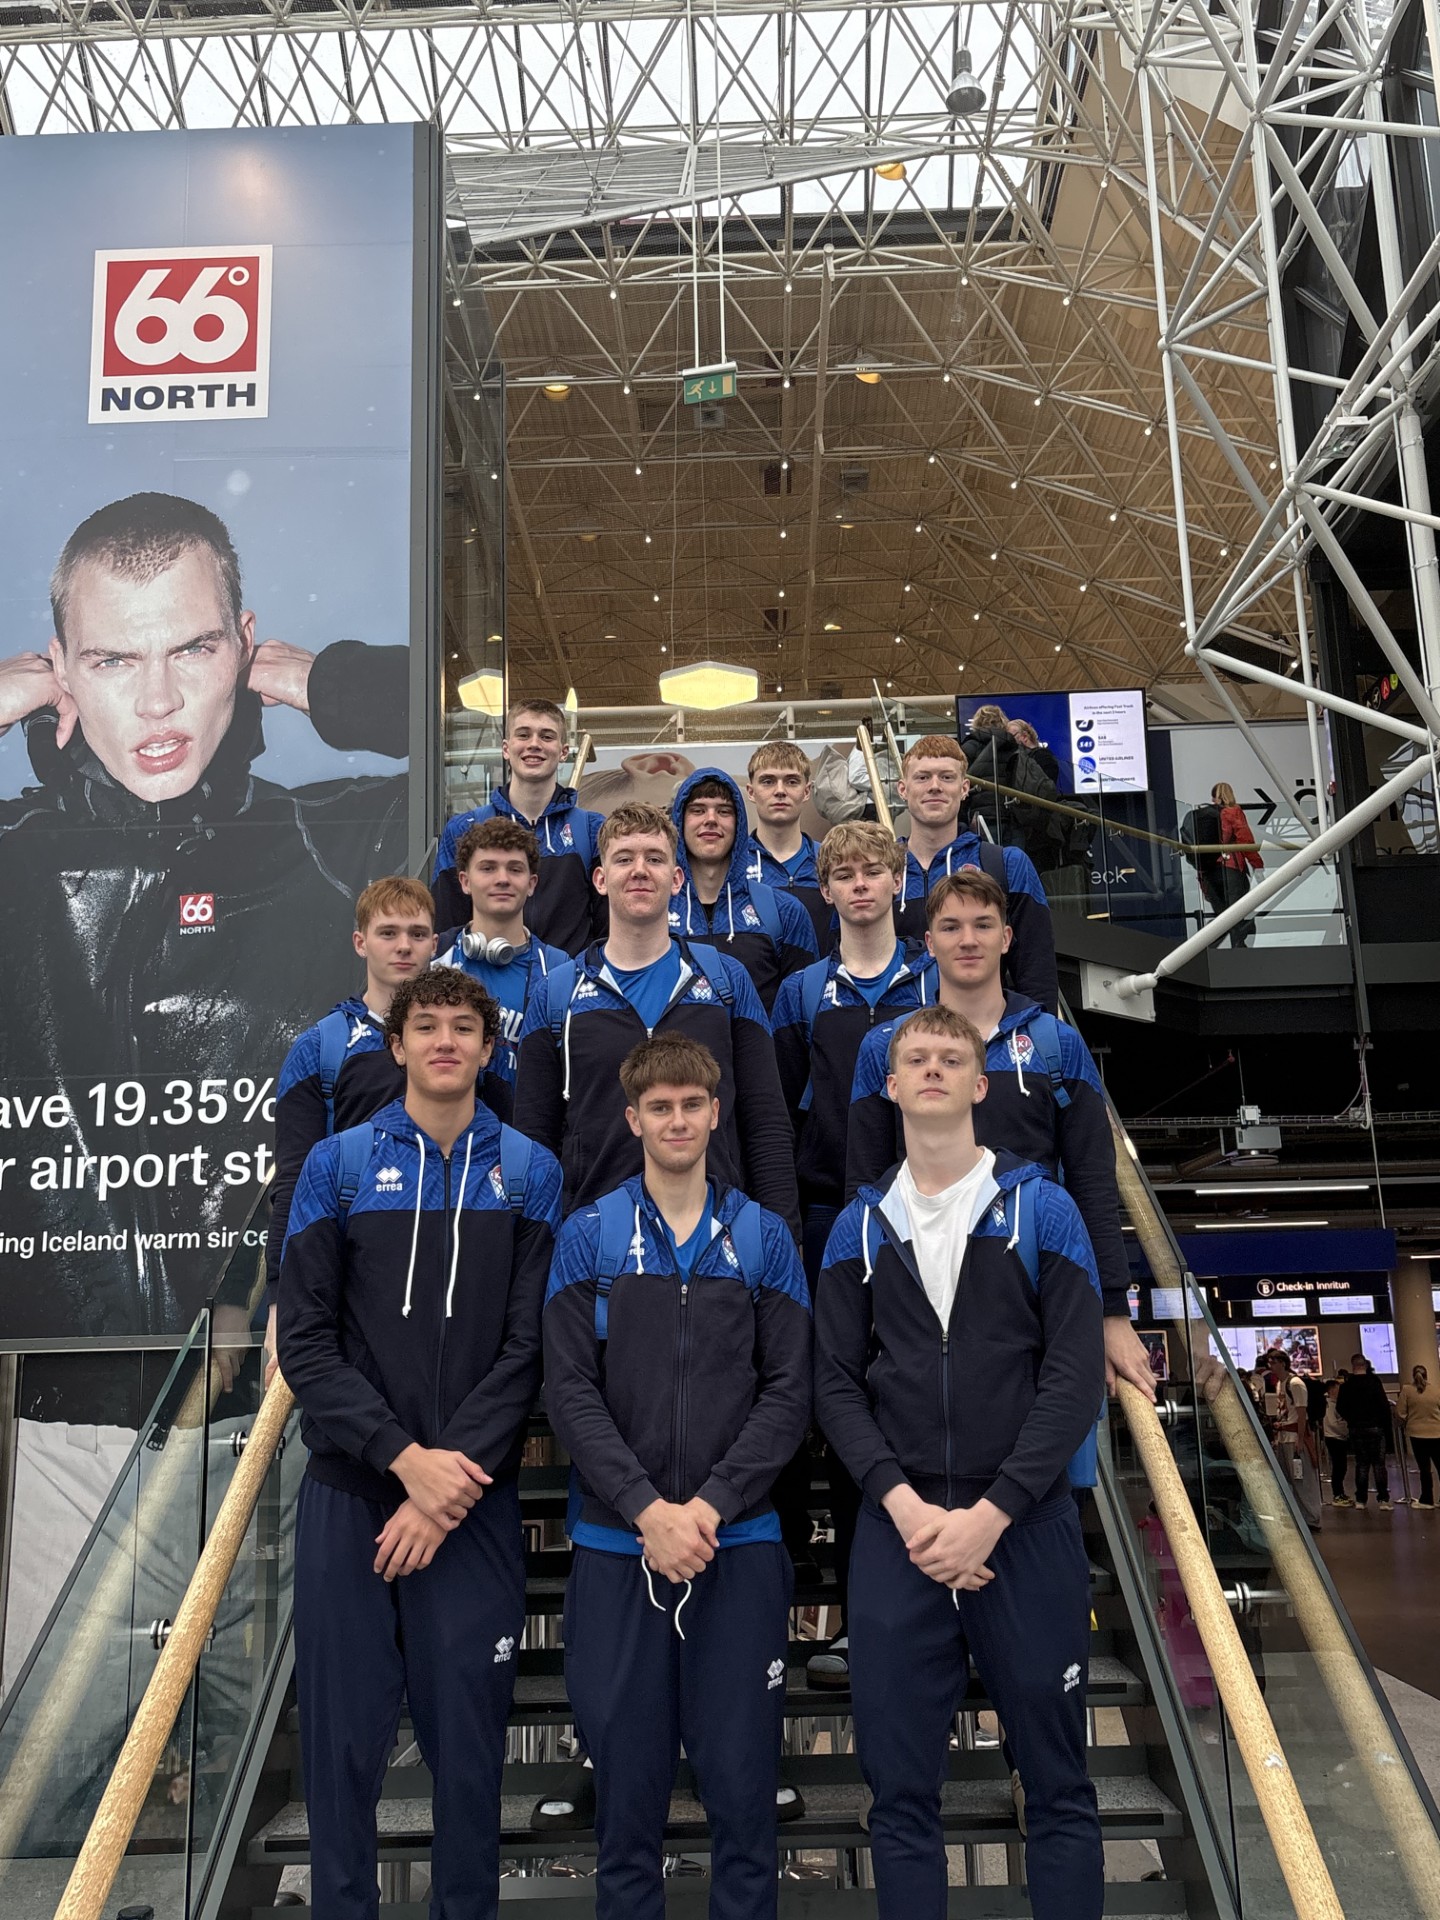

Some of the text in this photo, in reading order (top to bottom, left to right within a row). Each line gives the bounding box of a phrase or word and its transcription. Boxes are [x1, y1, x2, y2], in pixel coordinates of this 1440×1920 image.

[100, 382, 256, 412] NORTH
[180, 925, 216, 936] NORTH
[577, 990, 599, 1000] errea
[88, 1077, 276, 1127] 19.35%
[30, 1143, 209, 1202] airport
[376, 1183, 403, 1192] errea
[42, 1229, 128, 1252] Iceland
[134, 1230, 201, 1250] warm
[1276, 1282, 1314, 1292] Check-in
[1316, 1281, 1350, 1290] Innritun
